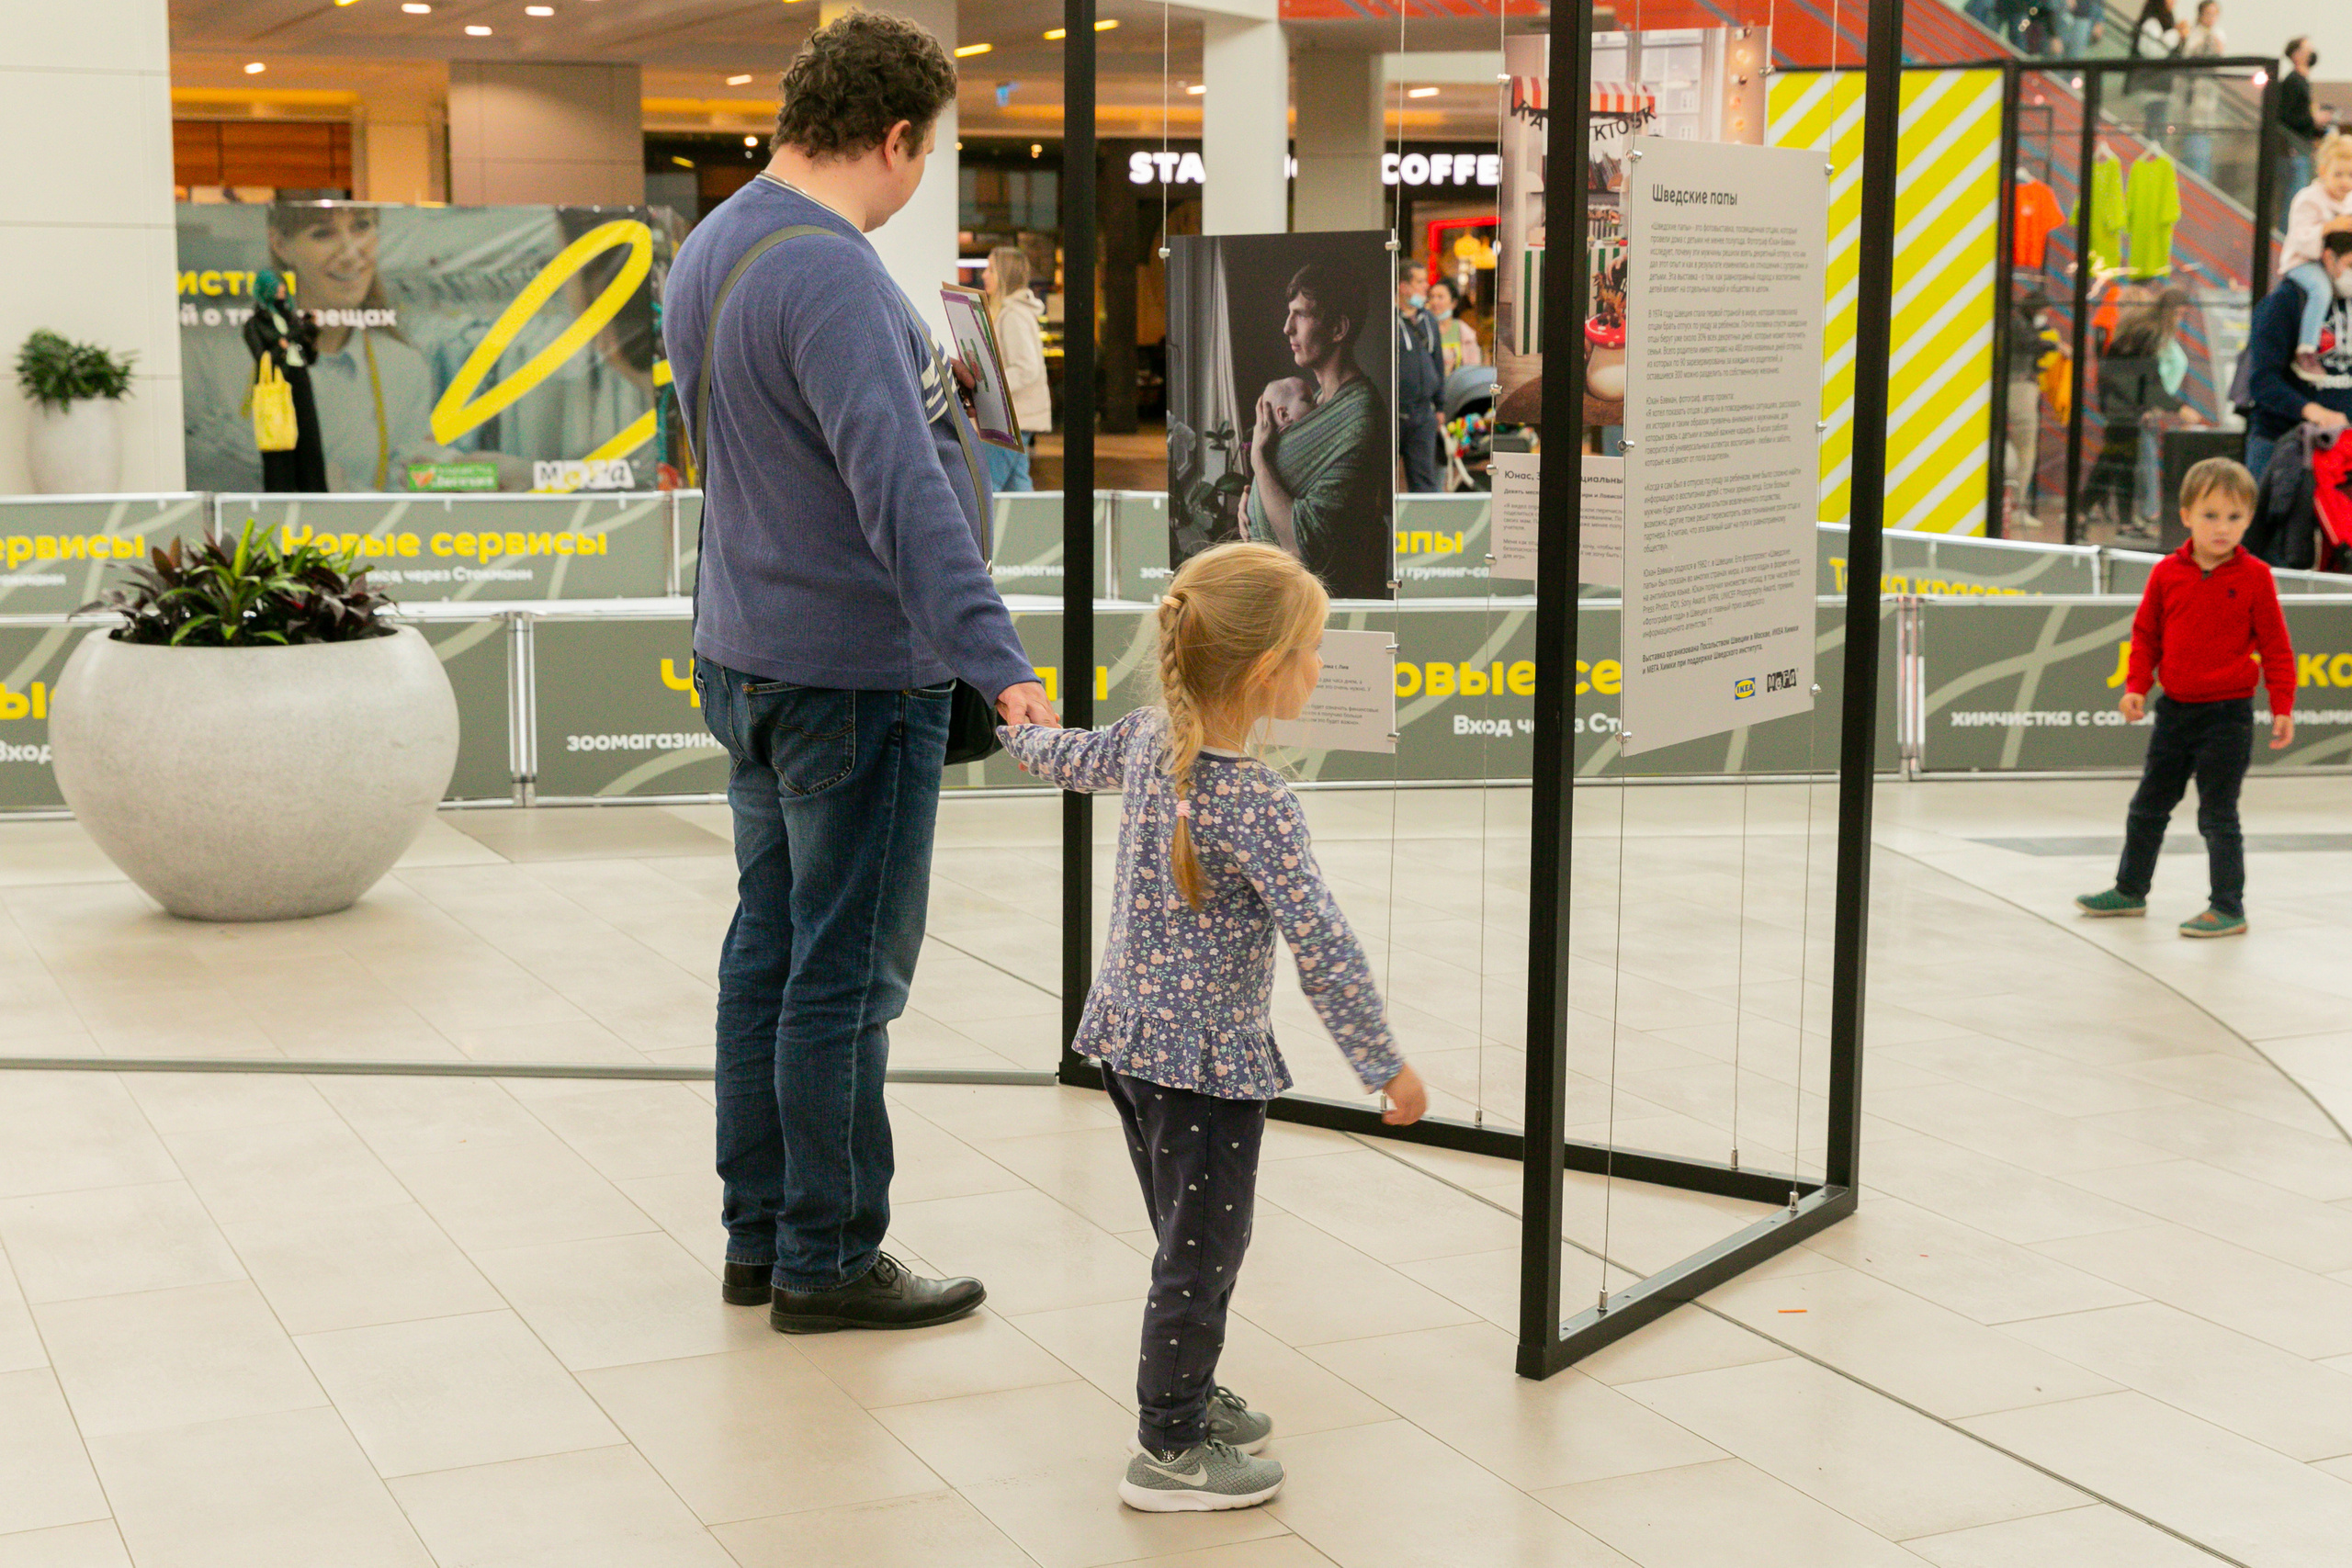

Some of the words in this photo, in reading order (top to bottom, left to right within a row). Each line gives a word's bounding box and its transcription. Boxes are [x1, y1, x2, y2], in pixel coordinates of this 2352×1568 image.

[1594, 105, 1657, 141] KIOSK
[1652, 183, 1707, 207] Шведские
[1710, 191, 1737, 206] папы
[1504, 470, 1534, 480] Юнас,
[280, 525, 421, 558] Новые
[430, 531, 607, 564] сервисы
[1642, 649, 1665, 661] Выставка
[1666, 645, 1699, 659] организована
[1700, 637, 1729, 650] Посольством
[1730, 633, 1748, 646] Швеции
[1753, 628, 1770, 641] Москве,
[1771, 626, 1783, 636] ИКЕА
[1784, 623, 1798, 633] Химки
[1646, 662, 1658, 672] МЕГА
[1660, 660, 1676, 670] Химки
[1677, 660, 1686, 669] при
[1687, 654, 1712, 667] поддержке
[1713, 647, 1737, 661] Шведского
[1738, 644, 1762, 656] института.
[1395, 660, 1536, 698] овые
[1736, 682, 1753, 694] IKEA
[1453, 715, 1513, 738] Вход
[1951, 710, 2071, 727] химчистка
[2075, 711, 2090, 727] с
